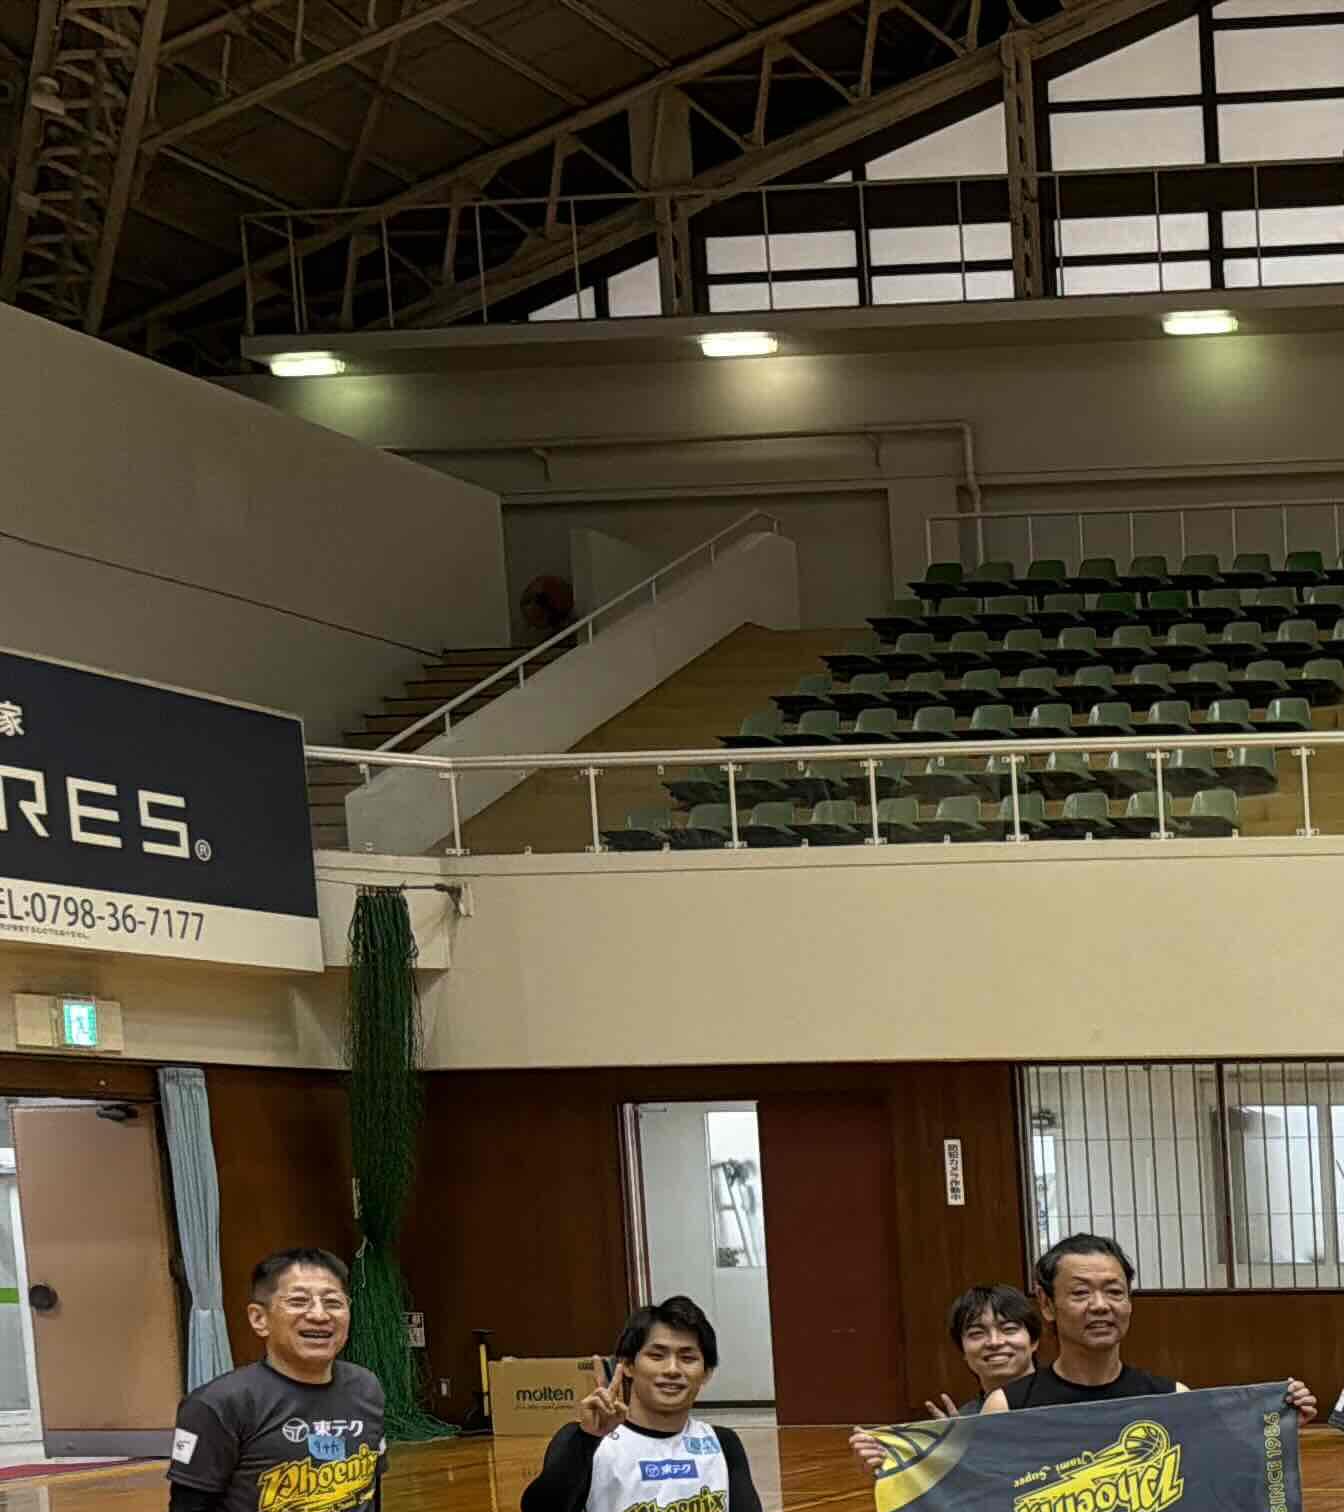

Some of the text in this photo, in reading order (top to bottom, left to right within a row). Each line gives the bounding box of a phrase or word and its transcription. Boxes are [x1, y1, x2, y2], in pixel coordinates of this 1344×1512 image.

[516, 1386, 574, 1401] molten
[312, 1420, 364, 1437] 東テク
[660, 1463, 691, 1475] 東テク
